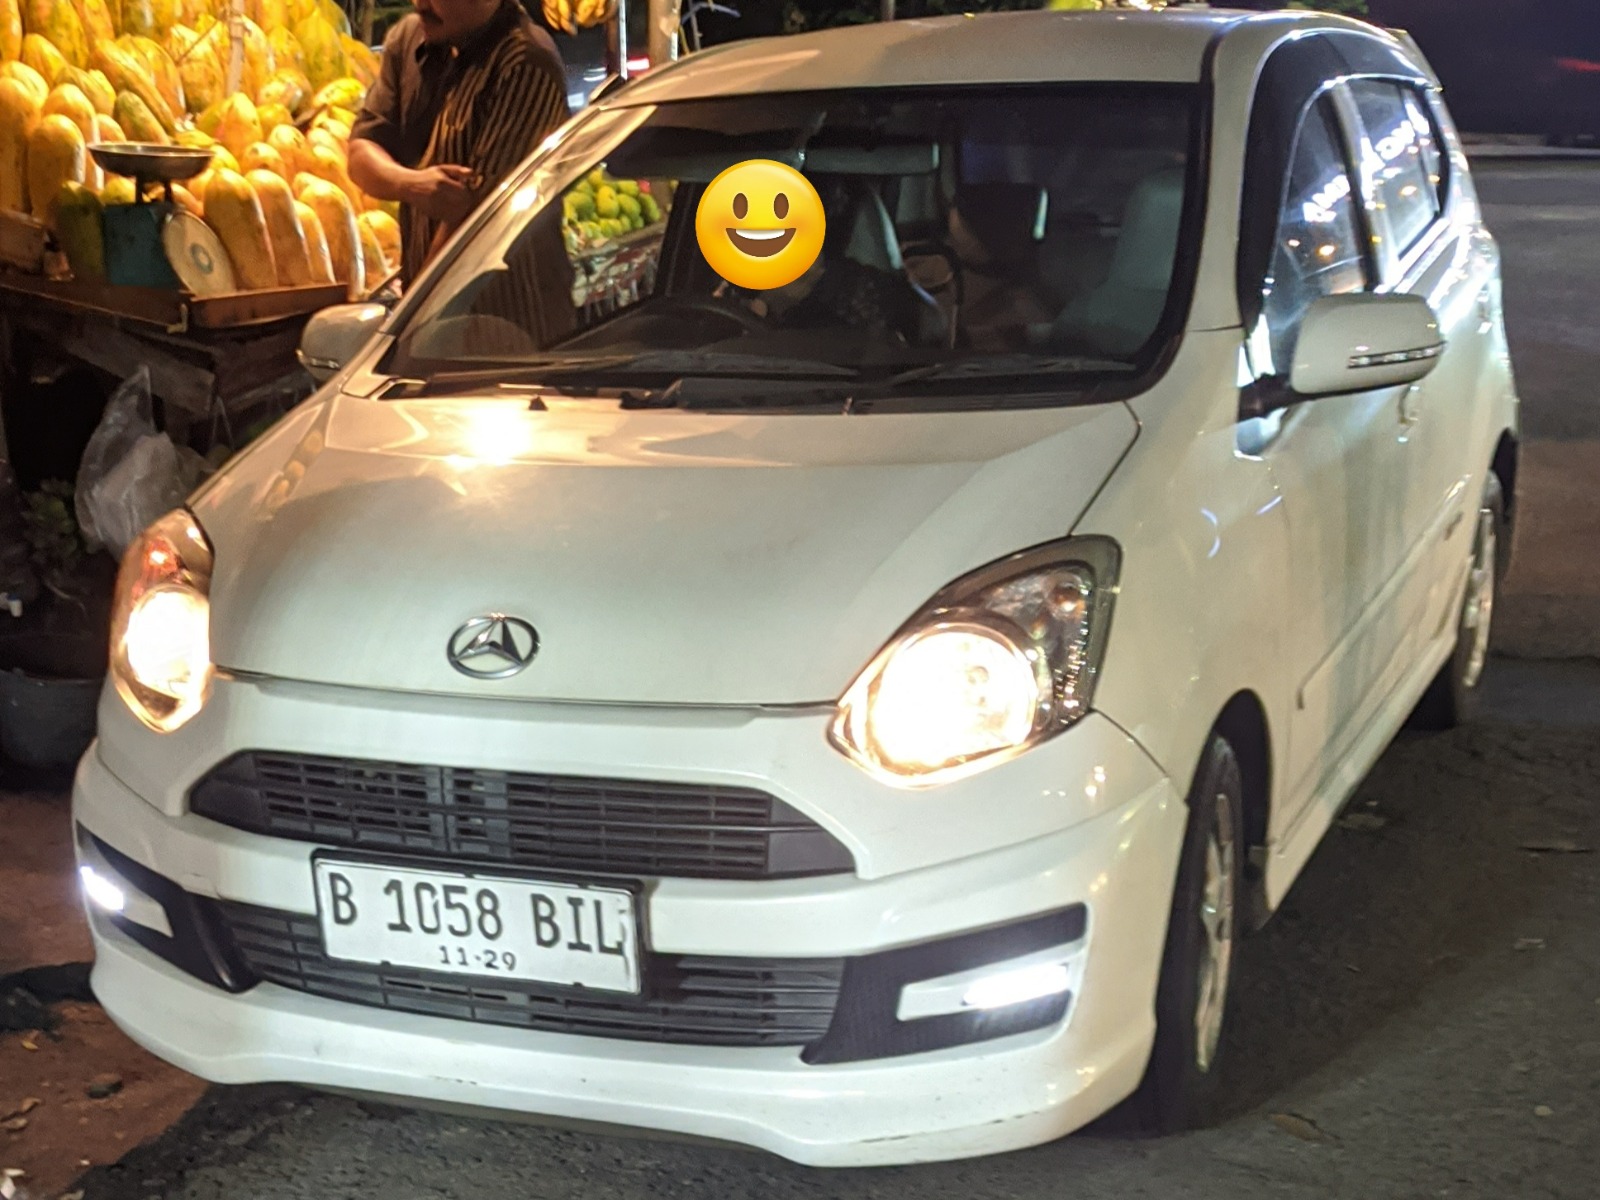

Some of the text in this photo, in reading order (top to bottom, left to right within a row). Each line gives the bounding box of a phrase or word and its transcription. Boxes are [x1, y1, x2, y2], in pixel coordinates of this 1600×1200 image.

[329, 872, 625, 956] B 1058 BIL
